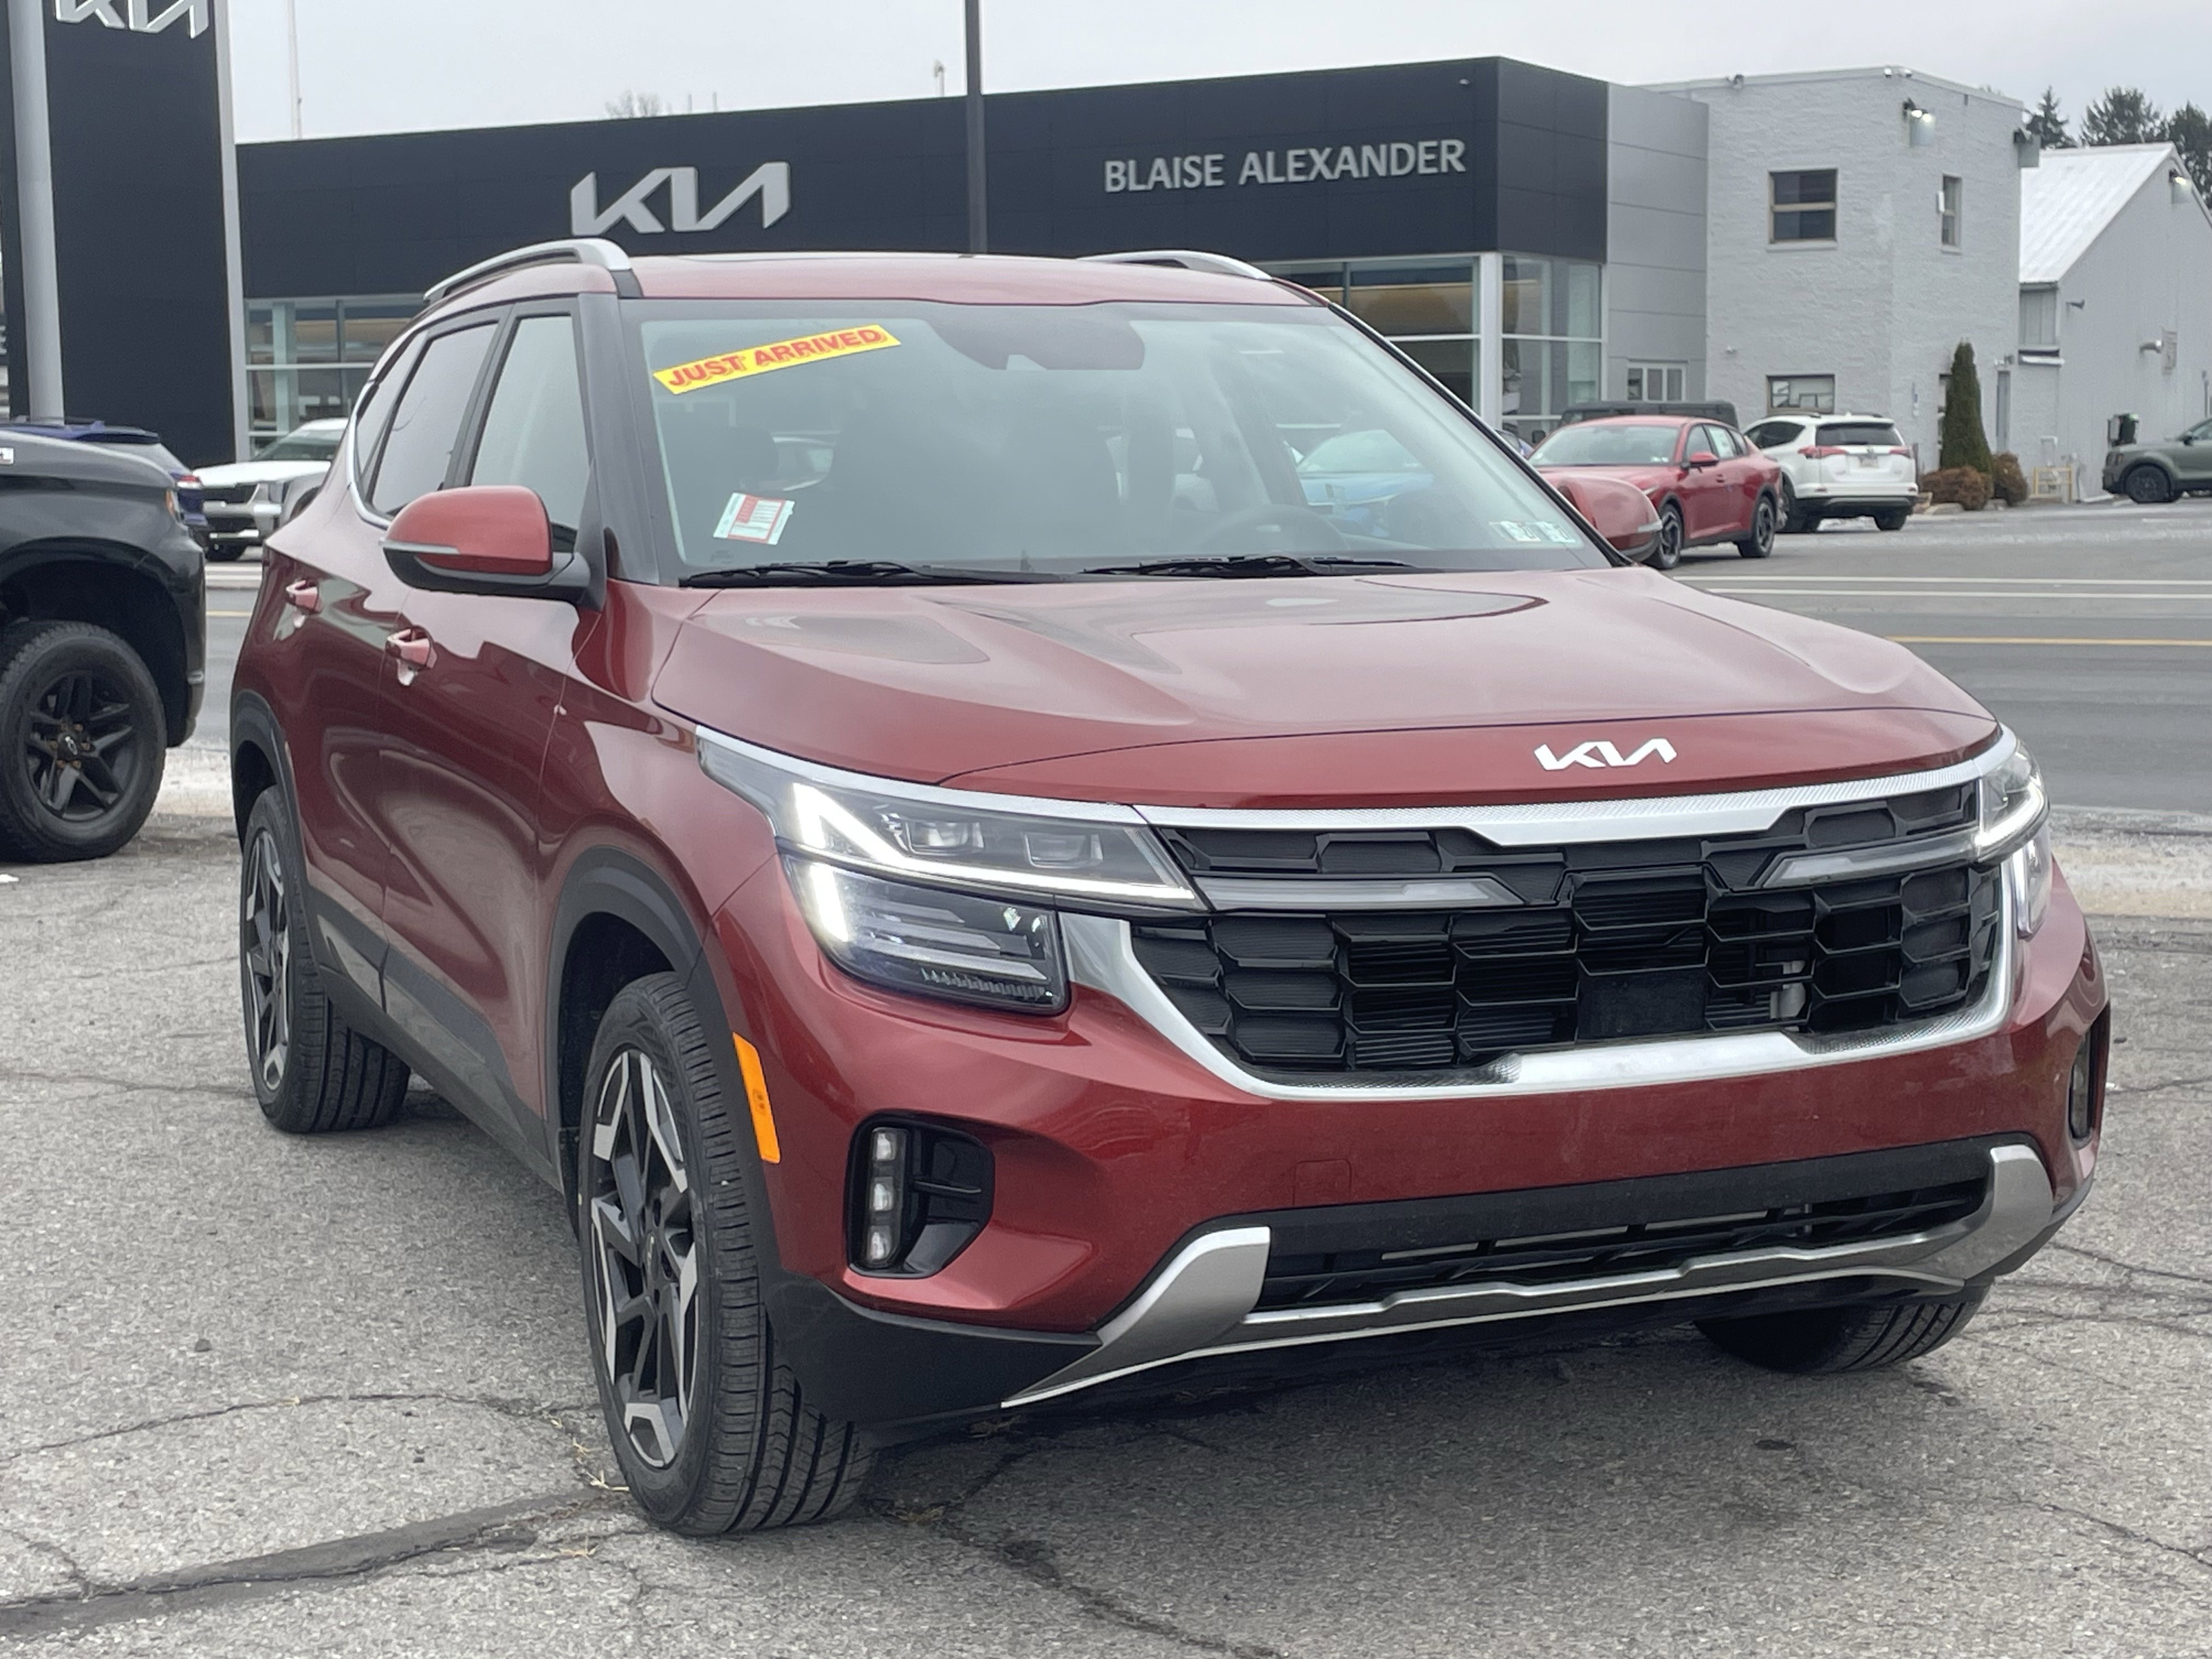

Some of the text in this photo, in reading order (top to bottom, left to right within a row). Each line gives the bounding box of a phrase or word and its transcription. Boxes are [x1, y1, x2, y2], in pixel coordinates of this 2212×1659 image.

[1105, 138, 1466, 193] BLAISE ALEXANDER
[571, 162, 790, 236] KIA
[669, 329, 886, 387] JUST ARRIVED
[1534, 738, 1677, 770] KIA
